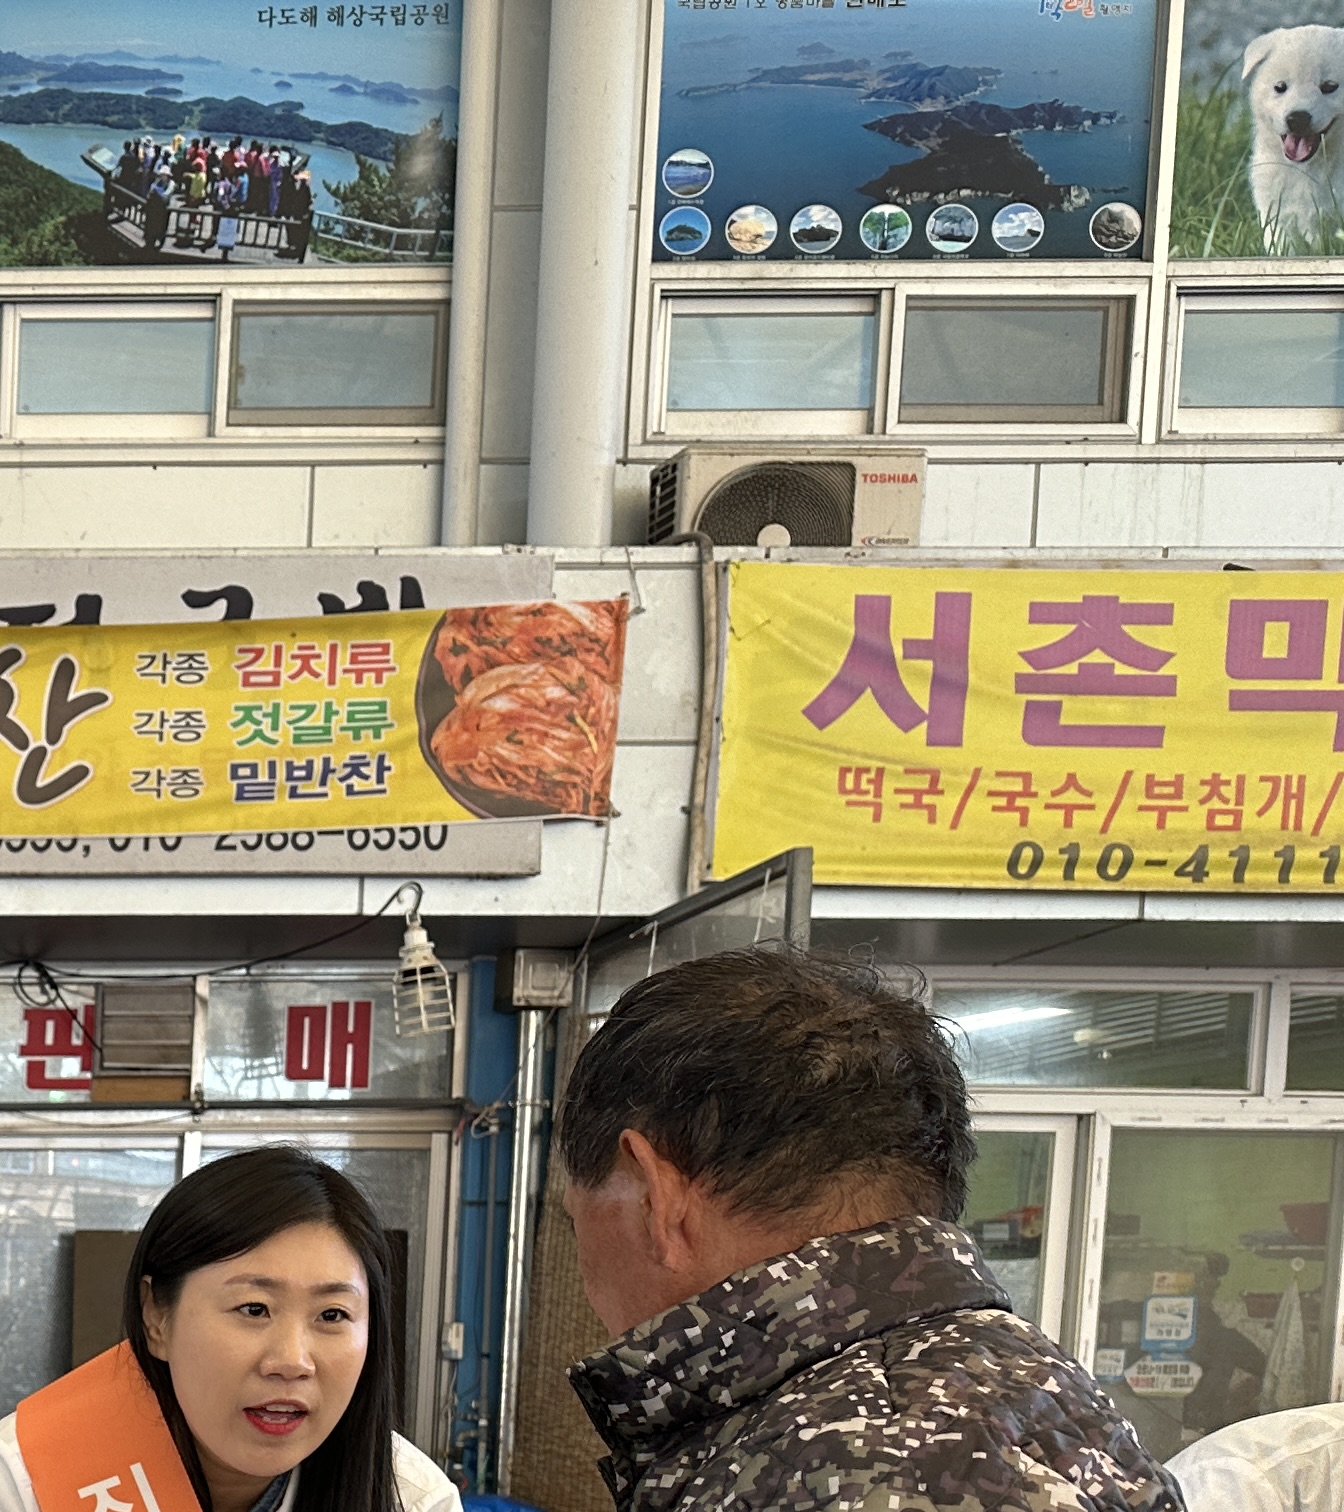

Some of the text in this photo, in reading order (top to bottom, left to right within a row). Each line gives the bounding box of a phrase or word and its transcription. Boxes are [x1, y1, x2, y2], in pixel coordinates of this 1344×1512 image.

[257, 3, 450, 28] 다도해 해상국립공원
[861, 473, 918, 484] TOSHIBA
[135, 642, 398, 689] 각종 김치류
[132, 700, 396, 747] 각종 젓갈류
[129, 752, 393, 803] 각종 밑반찬
[285, 1001, 372, 1089] 매
